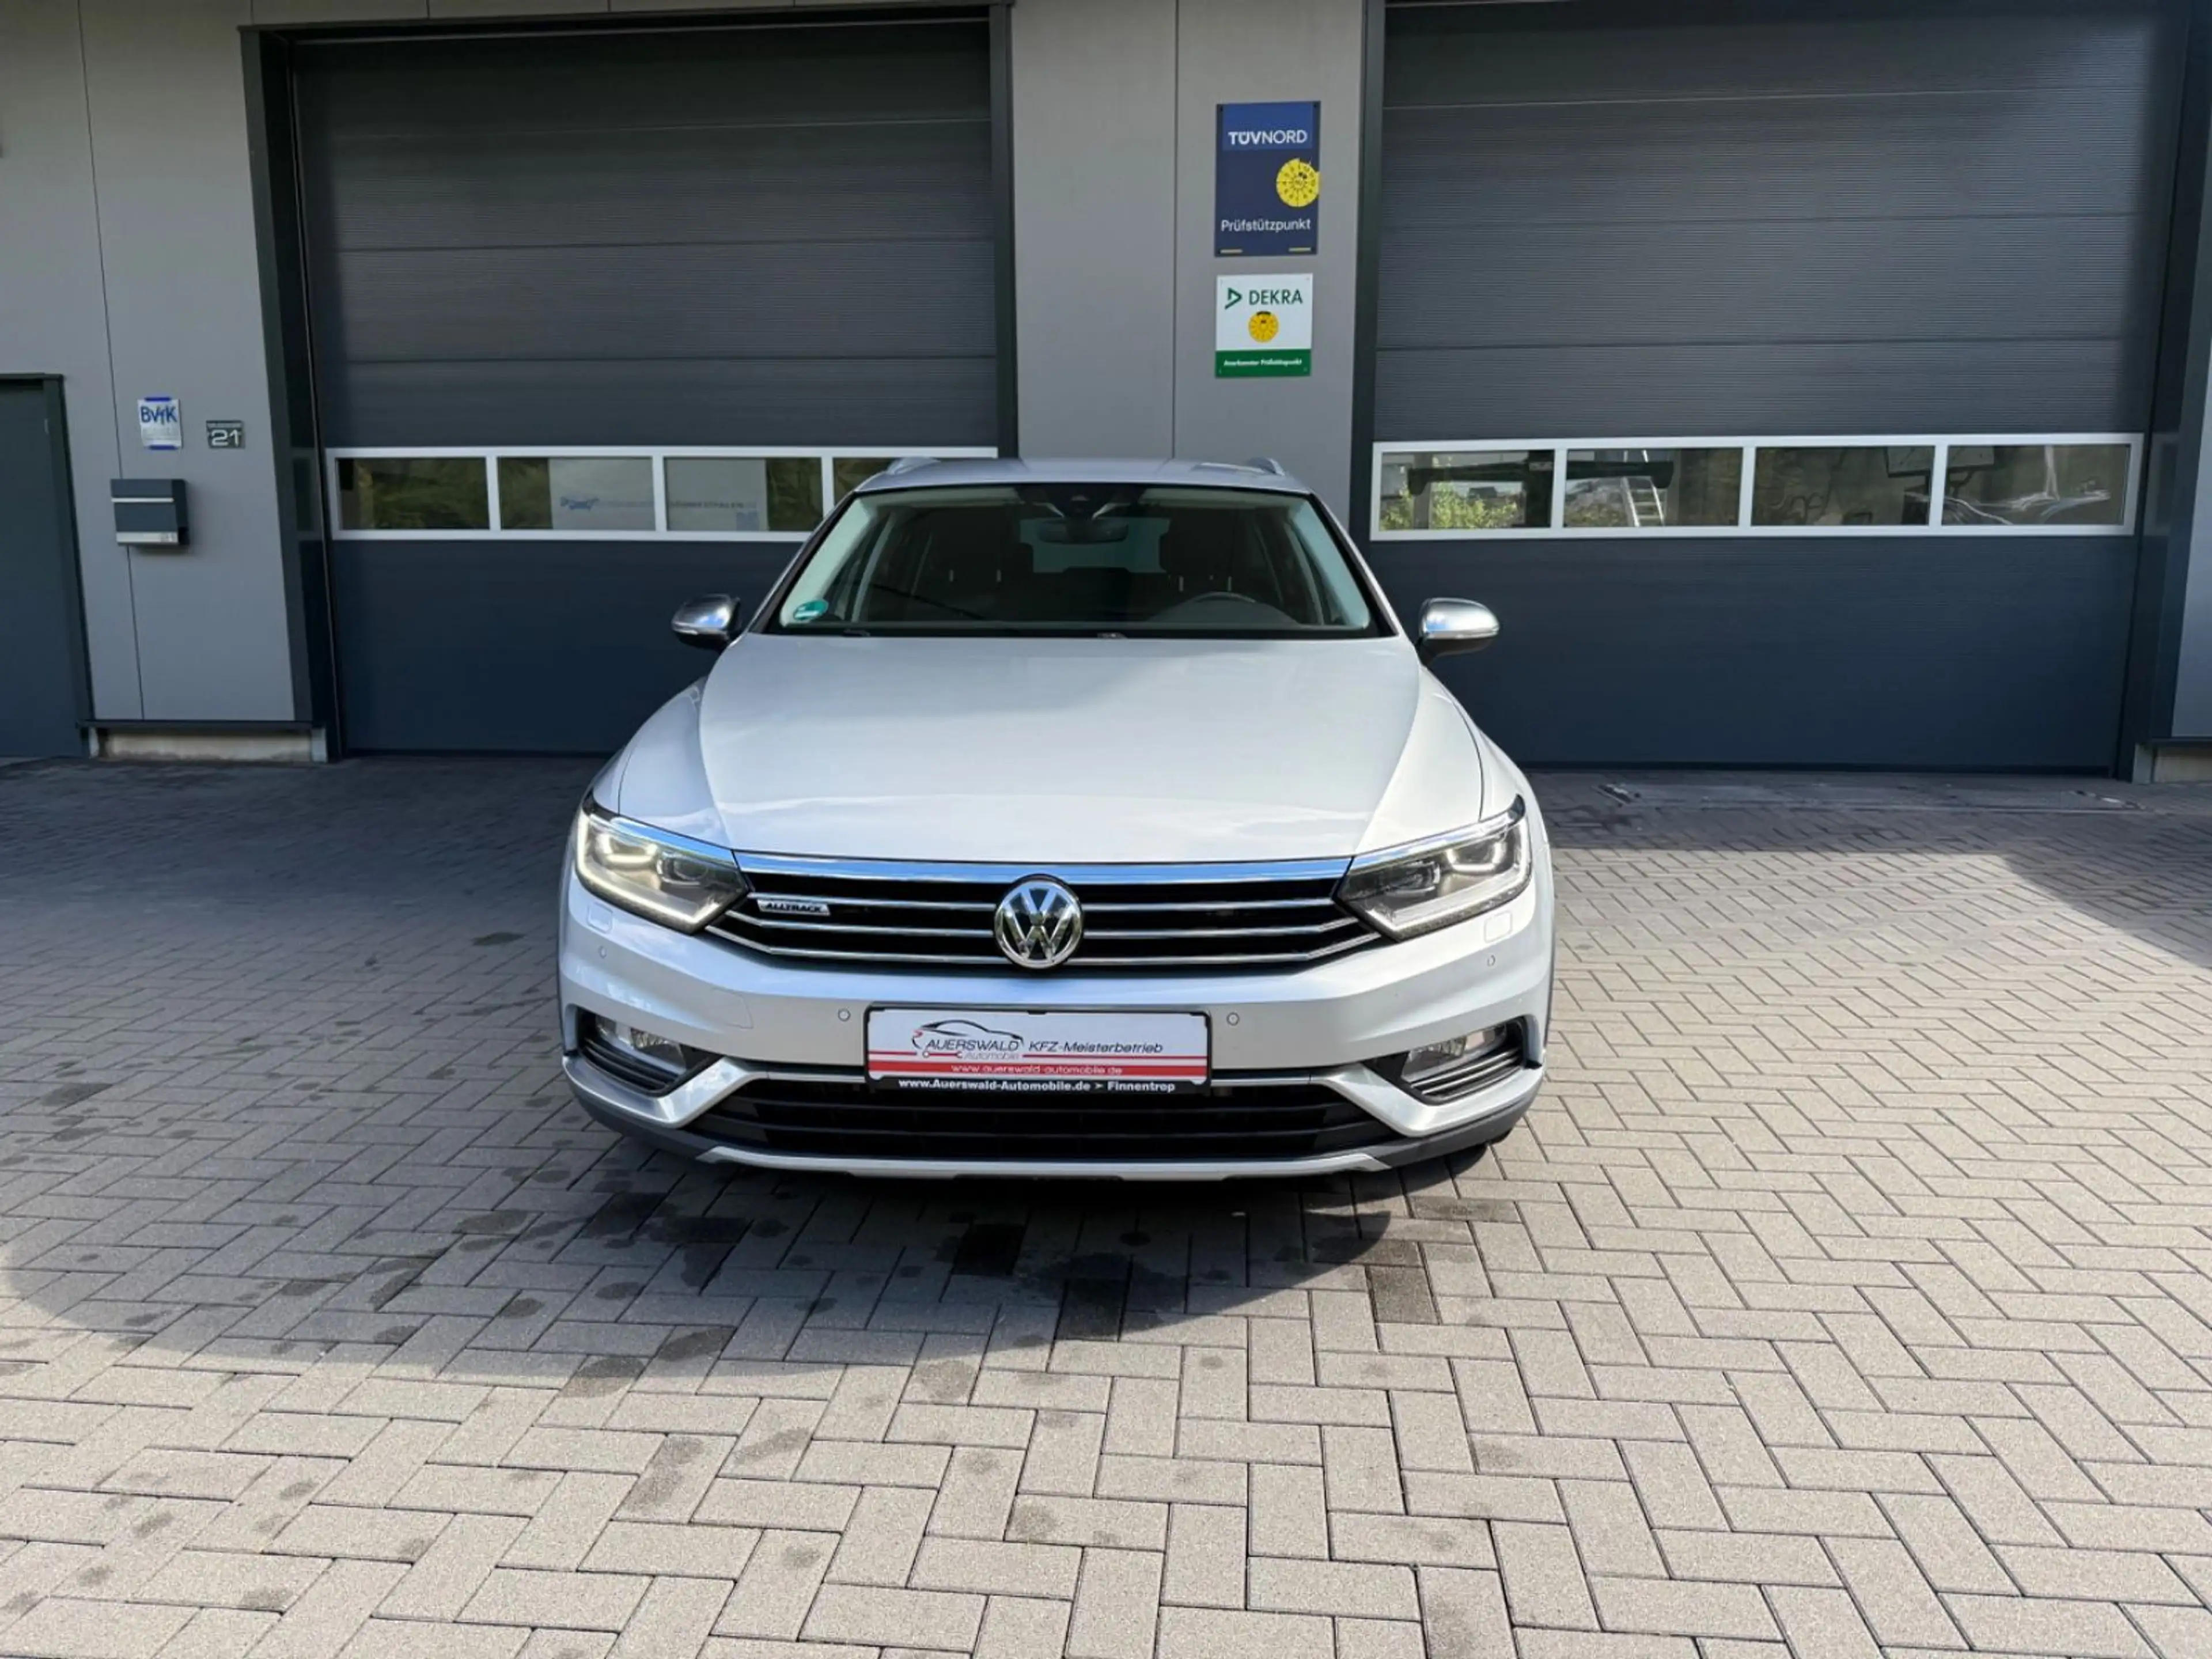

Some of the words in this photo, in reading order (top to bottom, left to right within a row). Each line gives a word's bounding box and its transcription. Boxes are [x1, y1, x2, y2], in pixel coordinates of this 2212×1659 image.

[1221, 218, 1311, 233] Prüfstützpunkt
[1249, 289, 1303, 305] DEKRA
[211, 429, 239, 446] 21
[763, 902, 823, 911] ALLTRACK
[926, 1039, 1019, 1052] AUERSWALD
[1028, 1040, 1164, 1053] KFZ-Meisterbetrieb
[899, 1078, 1090, 1092] www.Auerswald-Automobile.de
[1108, 1081, 1175, 1093] Finnentrop
